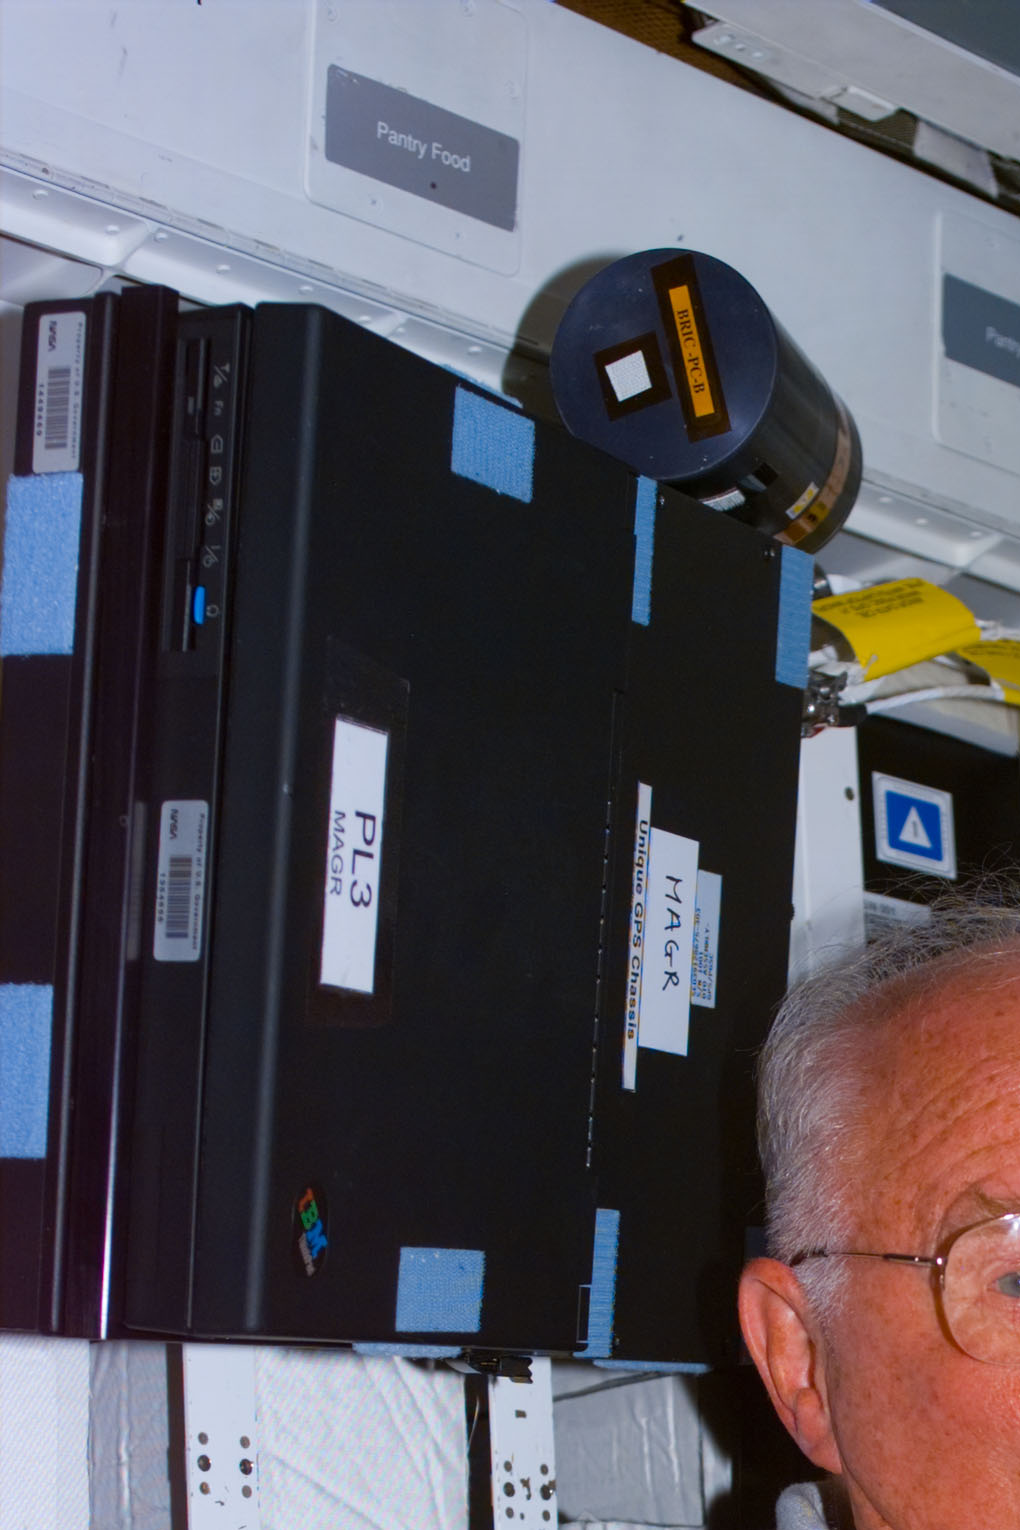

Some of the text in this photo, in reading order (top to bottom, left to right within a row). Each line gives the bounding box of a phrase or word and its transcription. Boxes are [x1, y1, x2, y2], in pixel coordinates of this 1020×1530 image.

[376, 120, 470, 172] Pantry Food
[48, 320, 58, 352] NASA
[677, 309, 705, 394] BRIC -PC-B
[169, 808, 179, 840] NASA
[196, 813, 206, 853] Property
[329, 810, 347, 896] MAGR
[350, 809, 377, 908] PL3
[626, 820, 649, 1041] Unique GPS Chassis
[662, 875, 683, 992] MAGR
[298, 1187, 328, 1260] IBM
